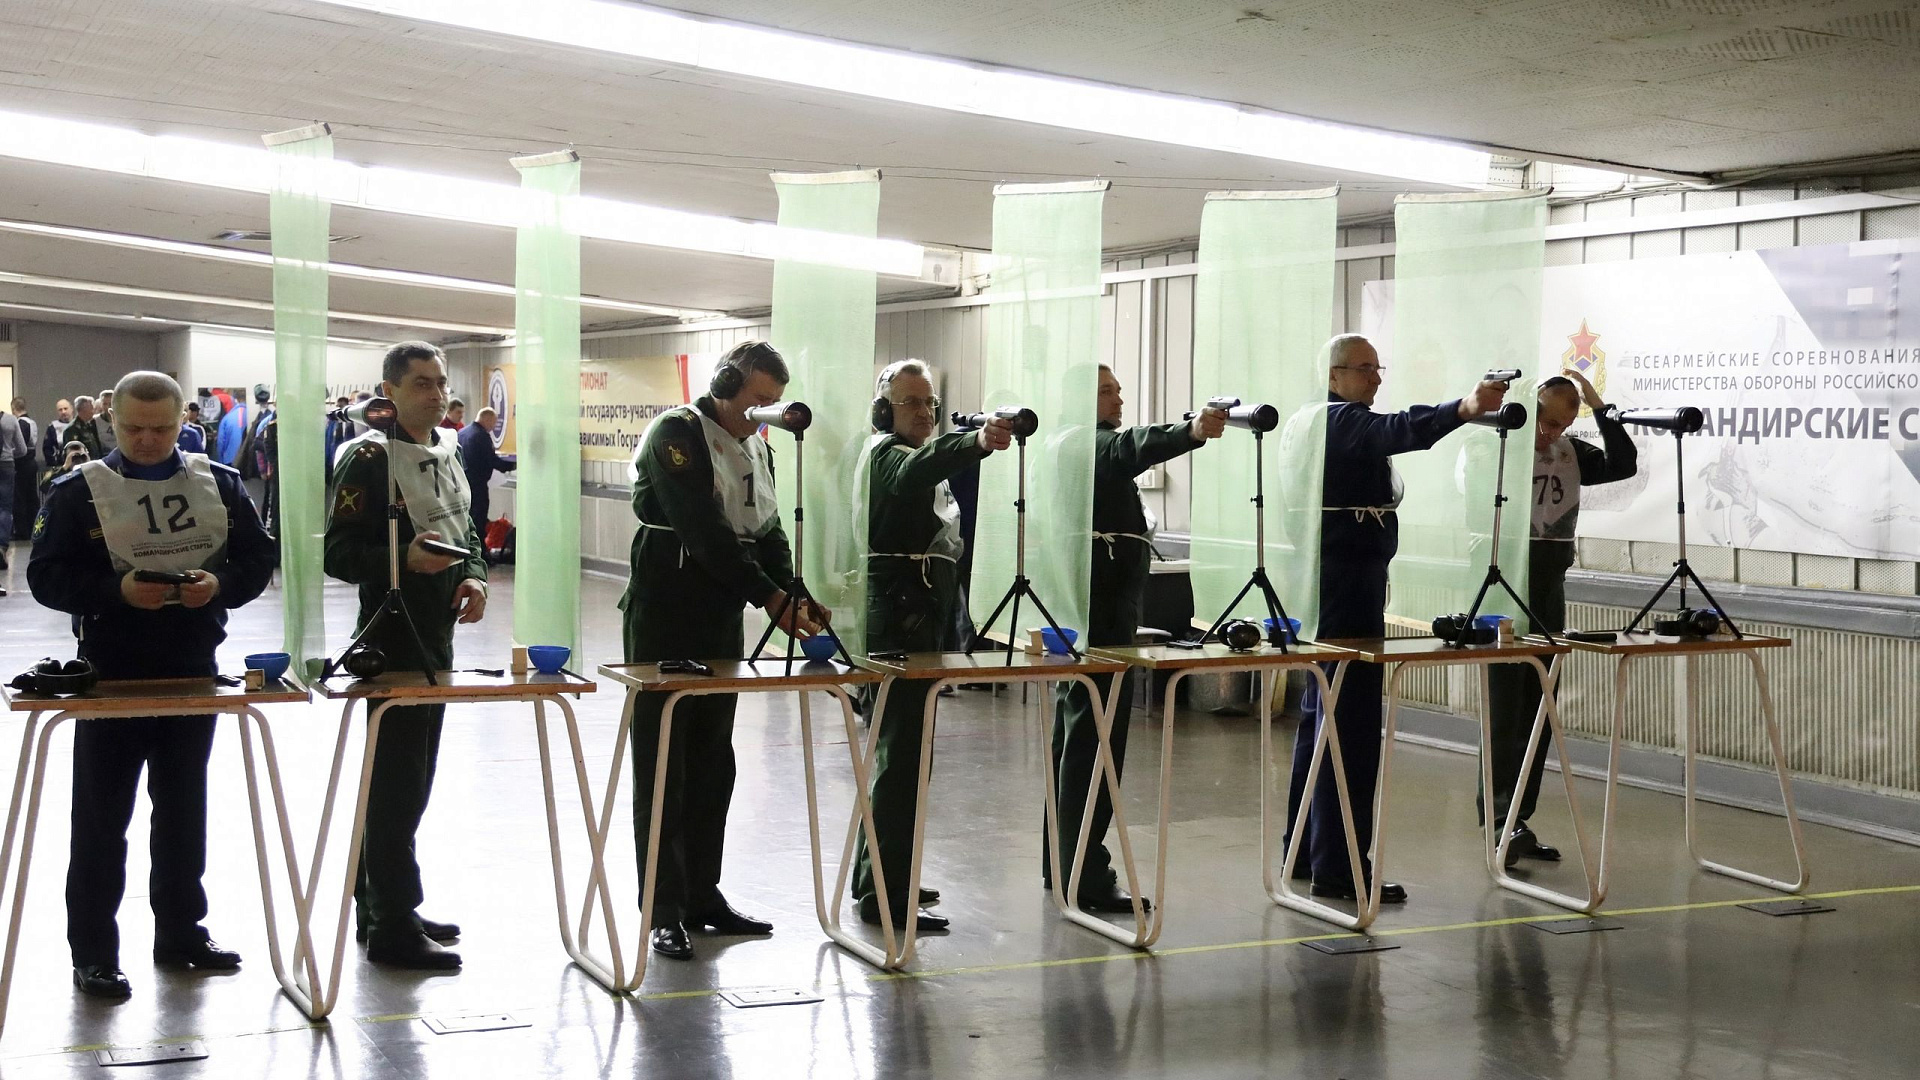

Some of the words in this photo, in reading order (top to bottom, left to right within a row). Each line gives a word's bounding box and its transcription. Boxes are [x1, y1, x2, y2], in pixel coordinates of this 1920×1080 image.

[1633, 351, 1760, 369] ВСЕАРМЕЙСКИЕ
[1772, 348, 1920, 366] СОРЕВНОВАНИЯ
[1633, 376, 1738, 391] МИНИСТЕРСТВА
[1743, 375, 1816, 390] ОБОРОНЫ
[1823, 371, 1919, 389] РОССИЙСКО
[617, 429, 642, 452] Госуд
[1633, 407, 1890, 445] КАНДИРСКИЕ
[419, 454, 461, 498] 71
[742, 472, 756, 507] 1
[137, 494, 197, 534] 12
[133, 546, 189, 558] КОМАНДИРСКИЕ
[189, 542, 213, 551] СТАРТЫ
